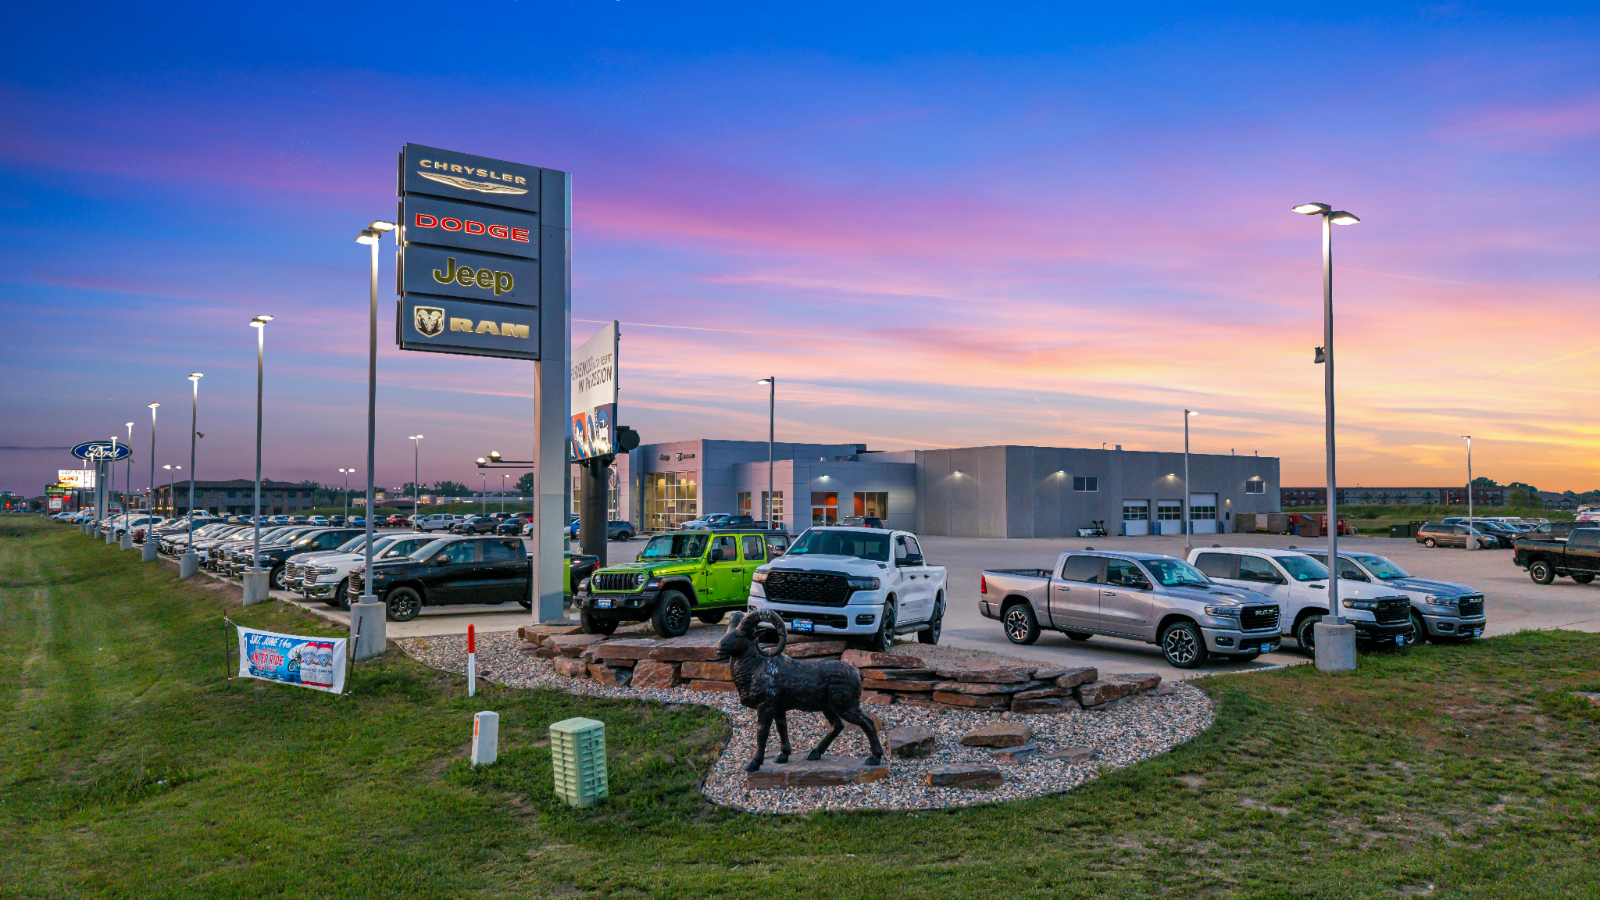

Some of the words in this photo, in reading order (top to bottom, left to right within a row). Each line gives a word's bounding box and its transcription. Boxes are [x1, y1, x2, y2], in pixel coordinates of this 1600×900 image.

[420, 159, 526, 185] CHRYSLER
[415, 213, 530, 243] DODGE
[433, 257, 515, 296] Jeep
[450, 317, 530, 339] RAM
[85, 445, 120, 458] Ford
